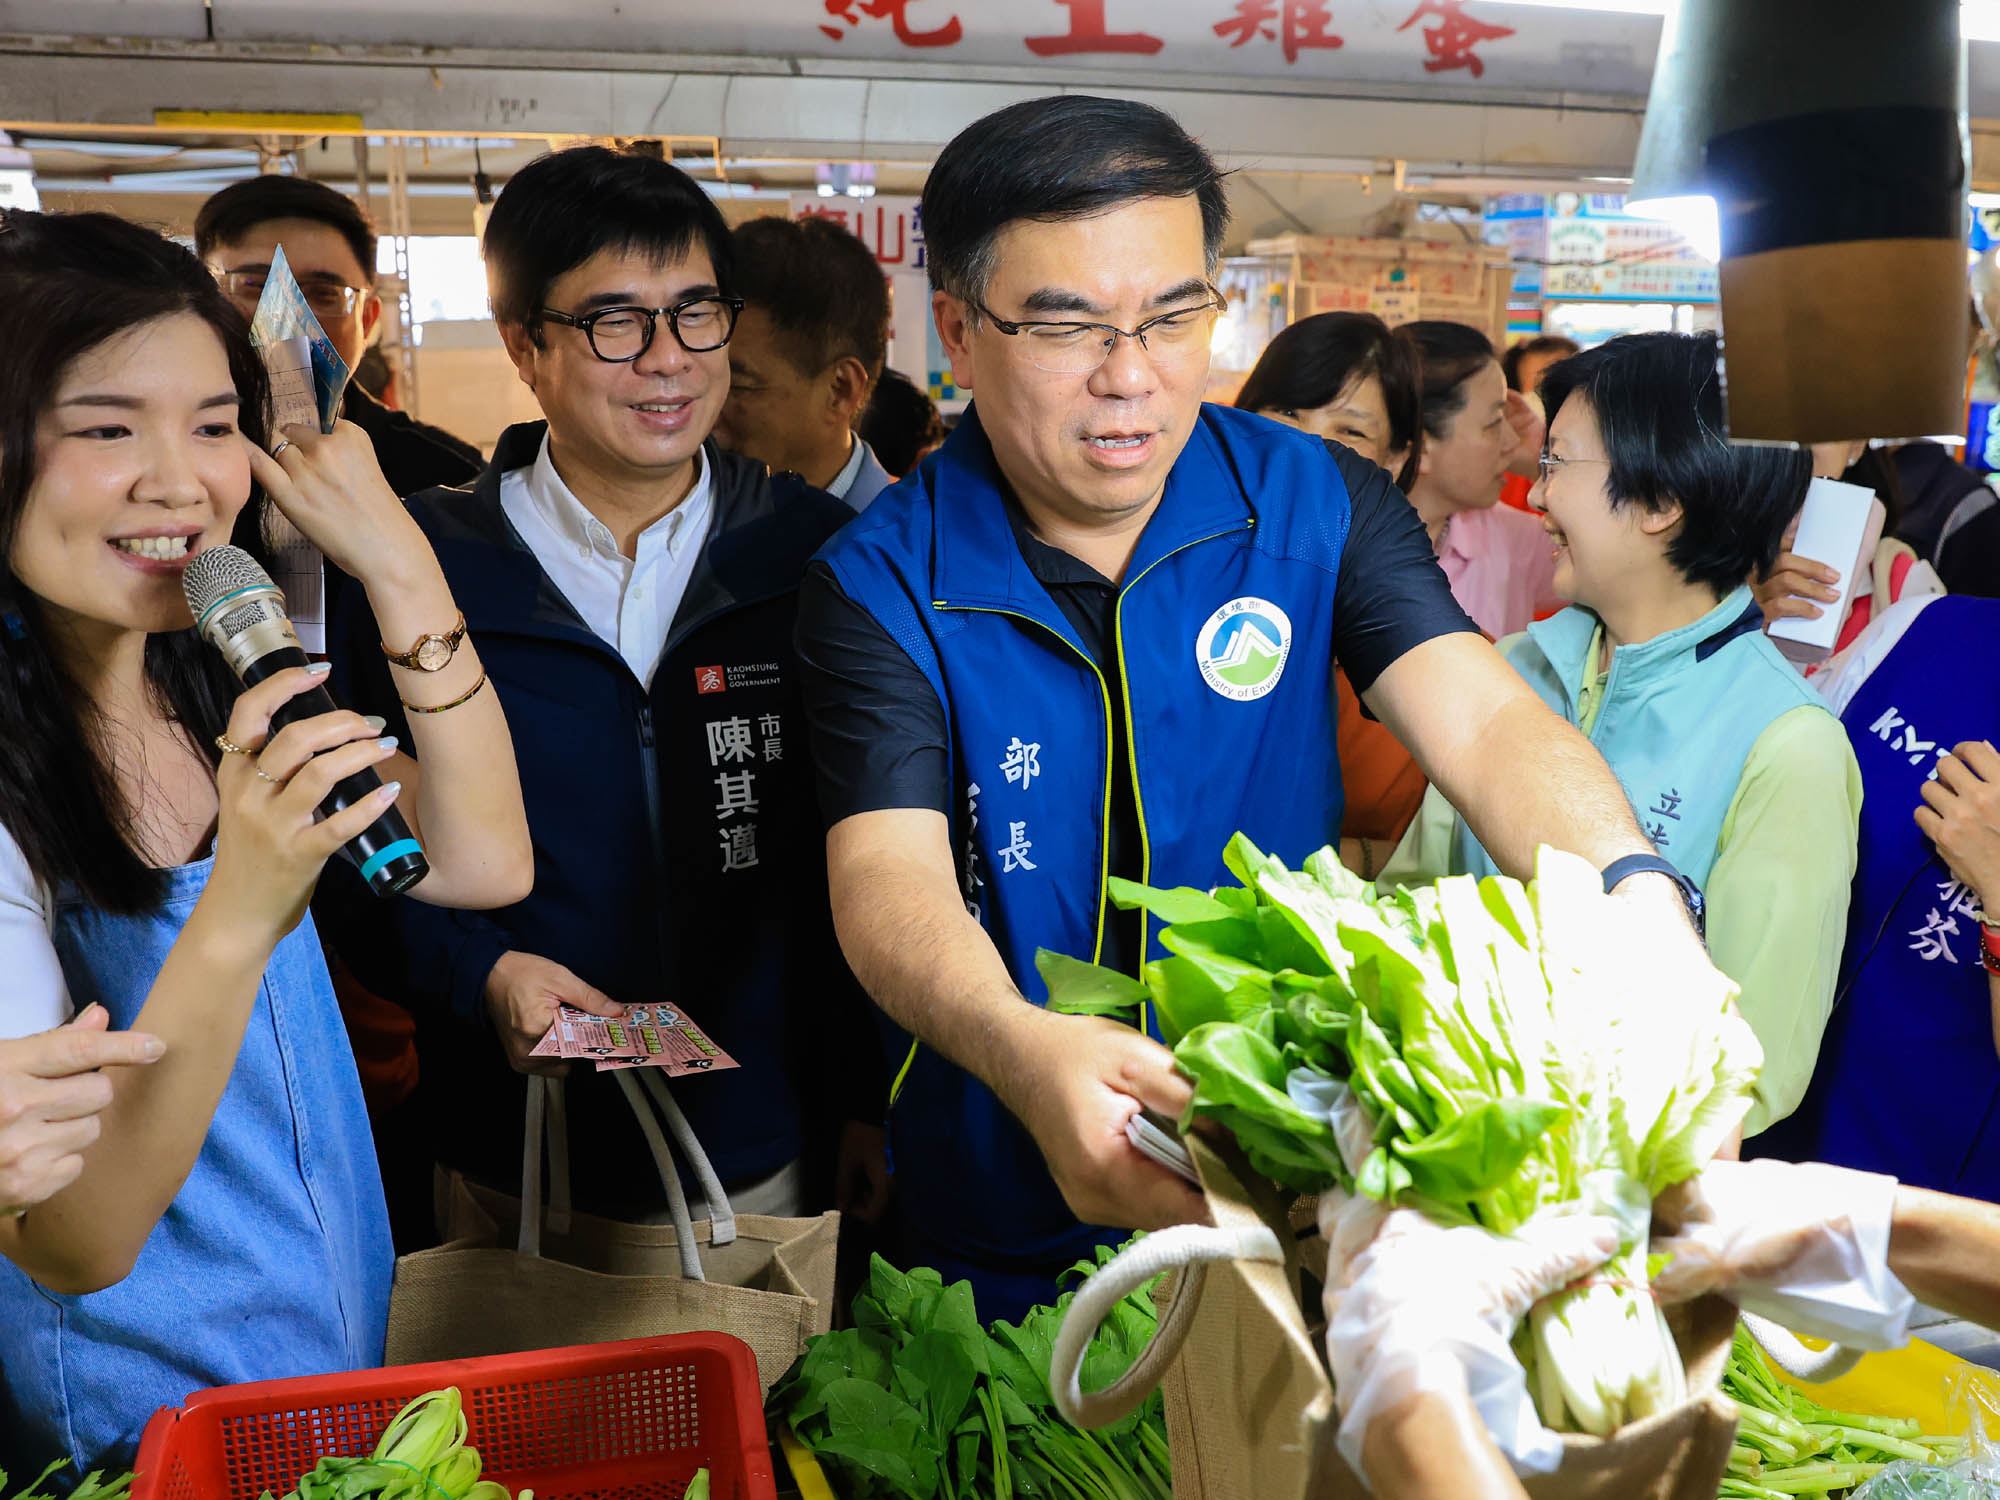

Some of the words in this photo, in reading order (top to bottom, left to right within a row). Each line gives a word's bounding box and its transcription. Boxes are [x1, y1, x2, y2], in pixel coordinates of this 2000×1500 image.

[726, 662, 780, 674] KAOHSIUNG
[727, 673, 747, 682] CITY
[729, 677, 781, 689] GOVERNMENT
[1201, 660, 1234, 695] Ministry
[1237, 688, 1248, 697] of
[758, 713, 783, 762] 市長
[706, 716, 760, 873] 陳其邁
[997, 737, 1041, 873] 部長
